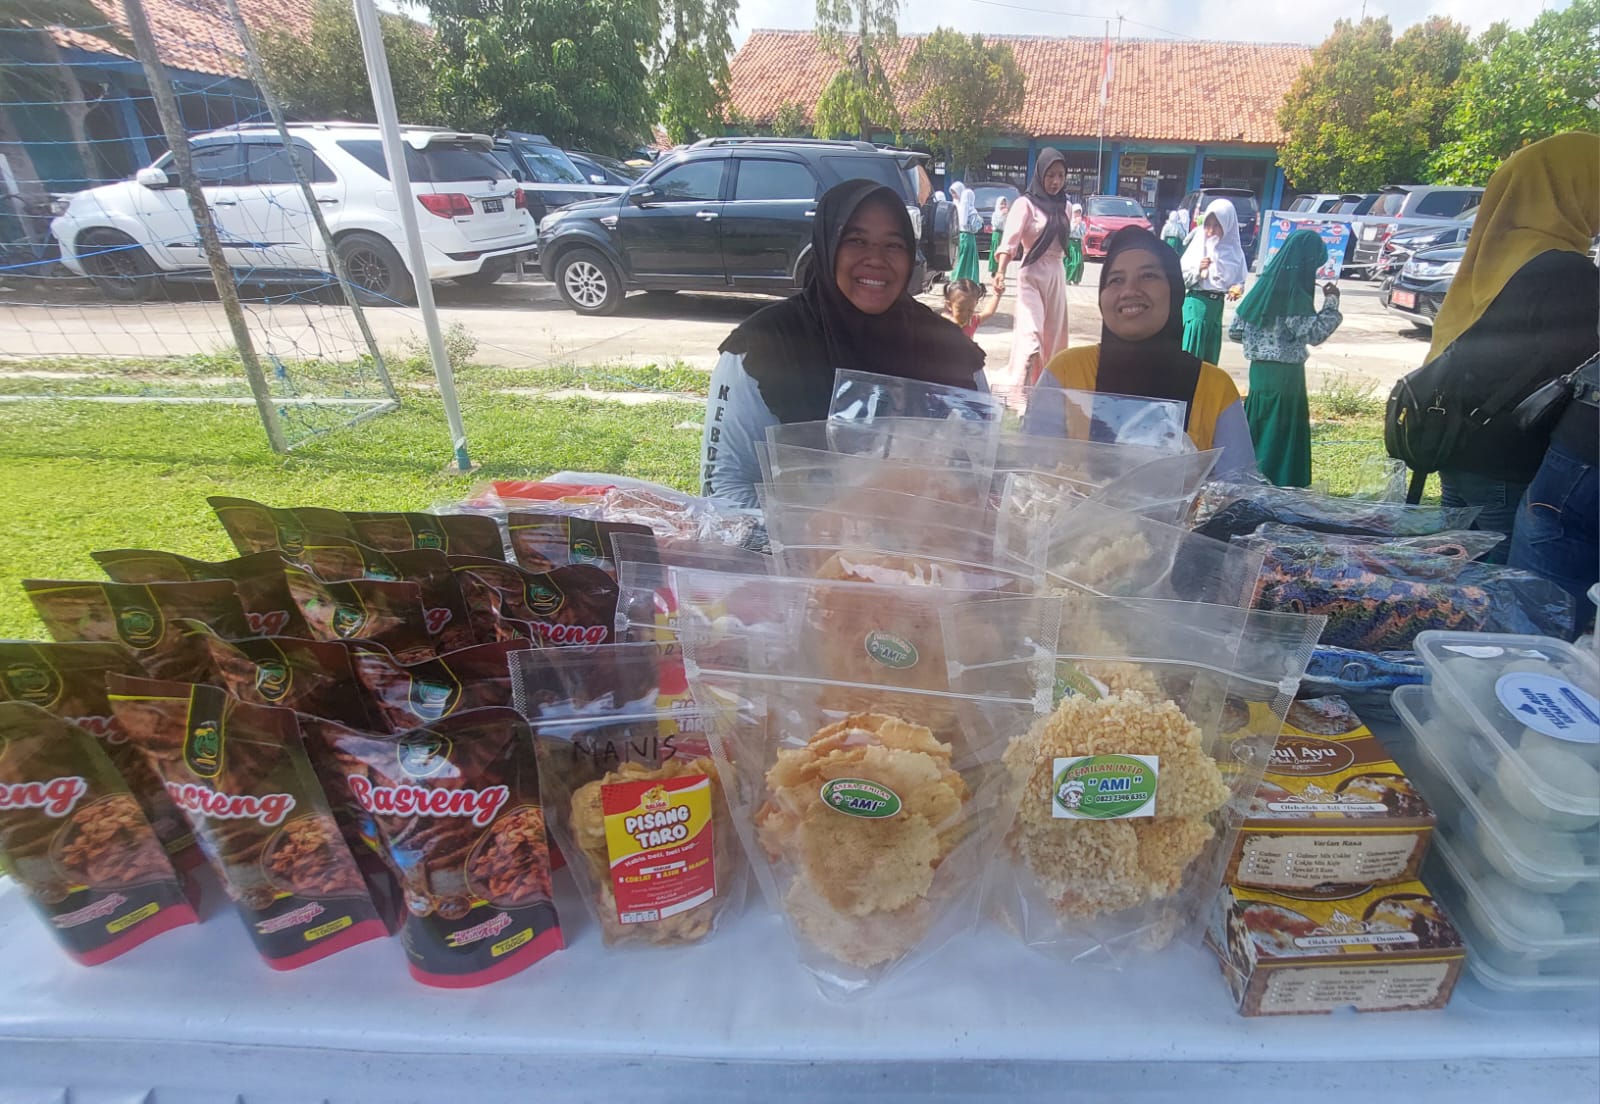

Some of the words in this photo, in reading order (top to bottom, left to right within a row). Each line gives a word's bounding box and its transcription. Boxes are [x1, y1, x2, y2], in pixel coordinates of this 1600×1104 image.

[531, 622, 608, 647] reng
[1301, 747, 1337, 760] Ayu
[1067, 764, 1113, 779] CEMILAN
[348, 774, 509, 827] Basreng
[624, 804, 692, 835] PISANG
[634, 824, 689, 850] TARO
